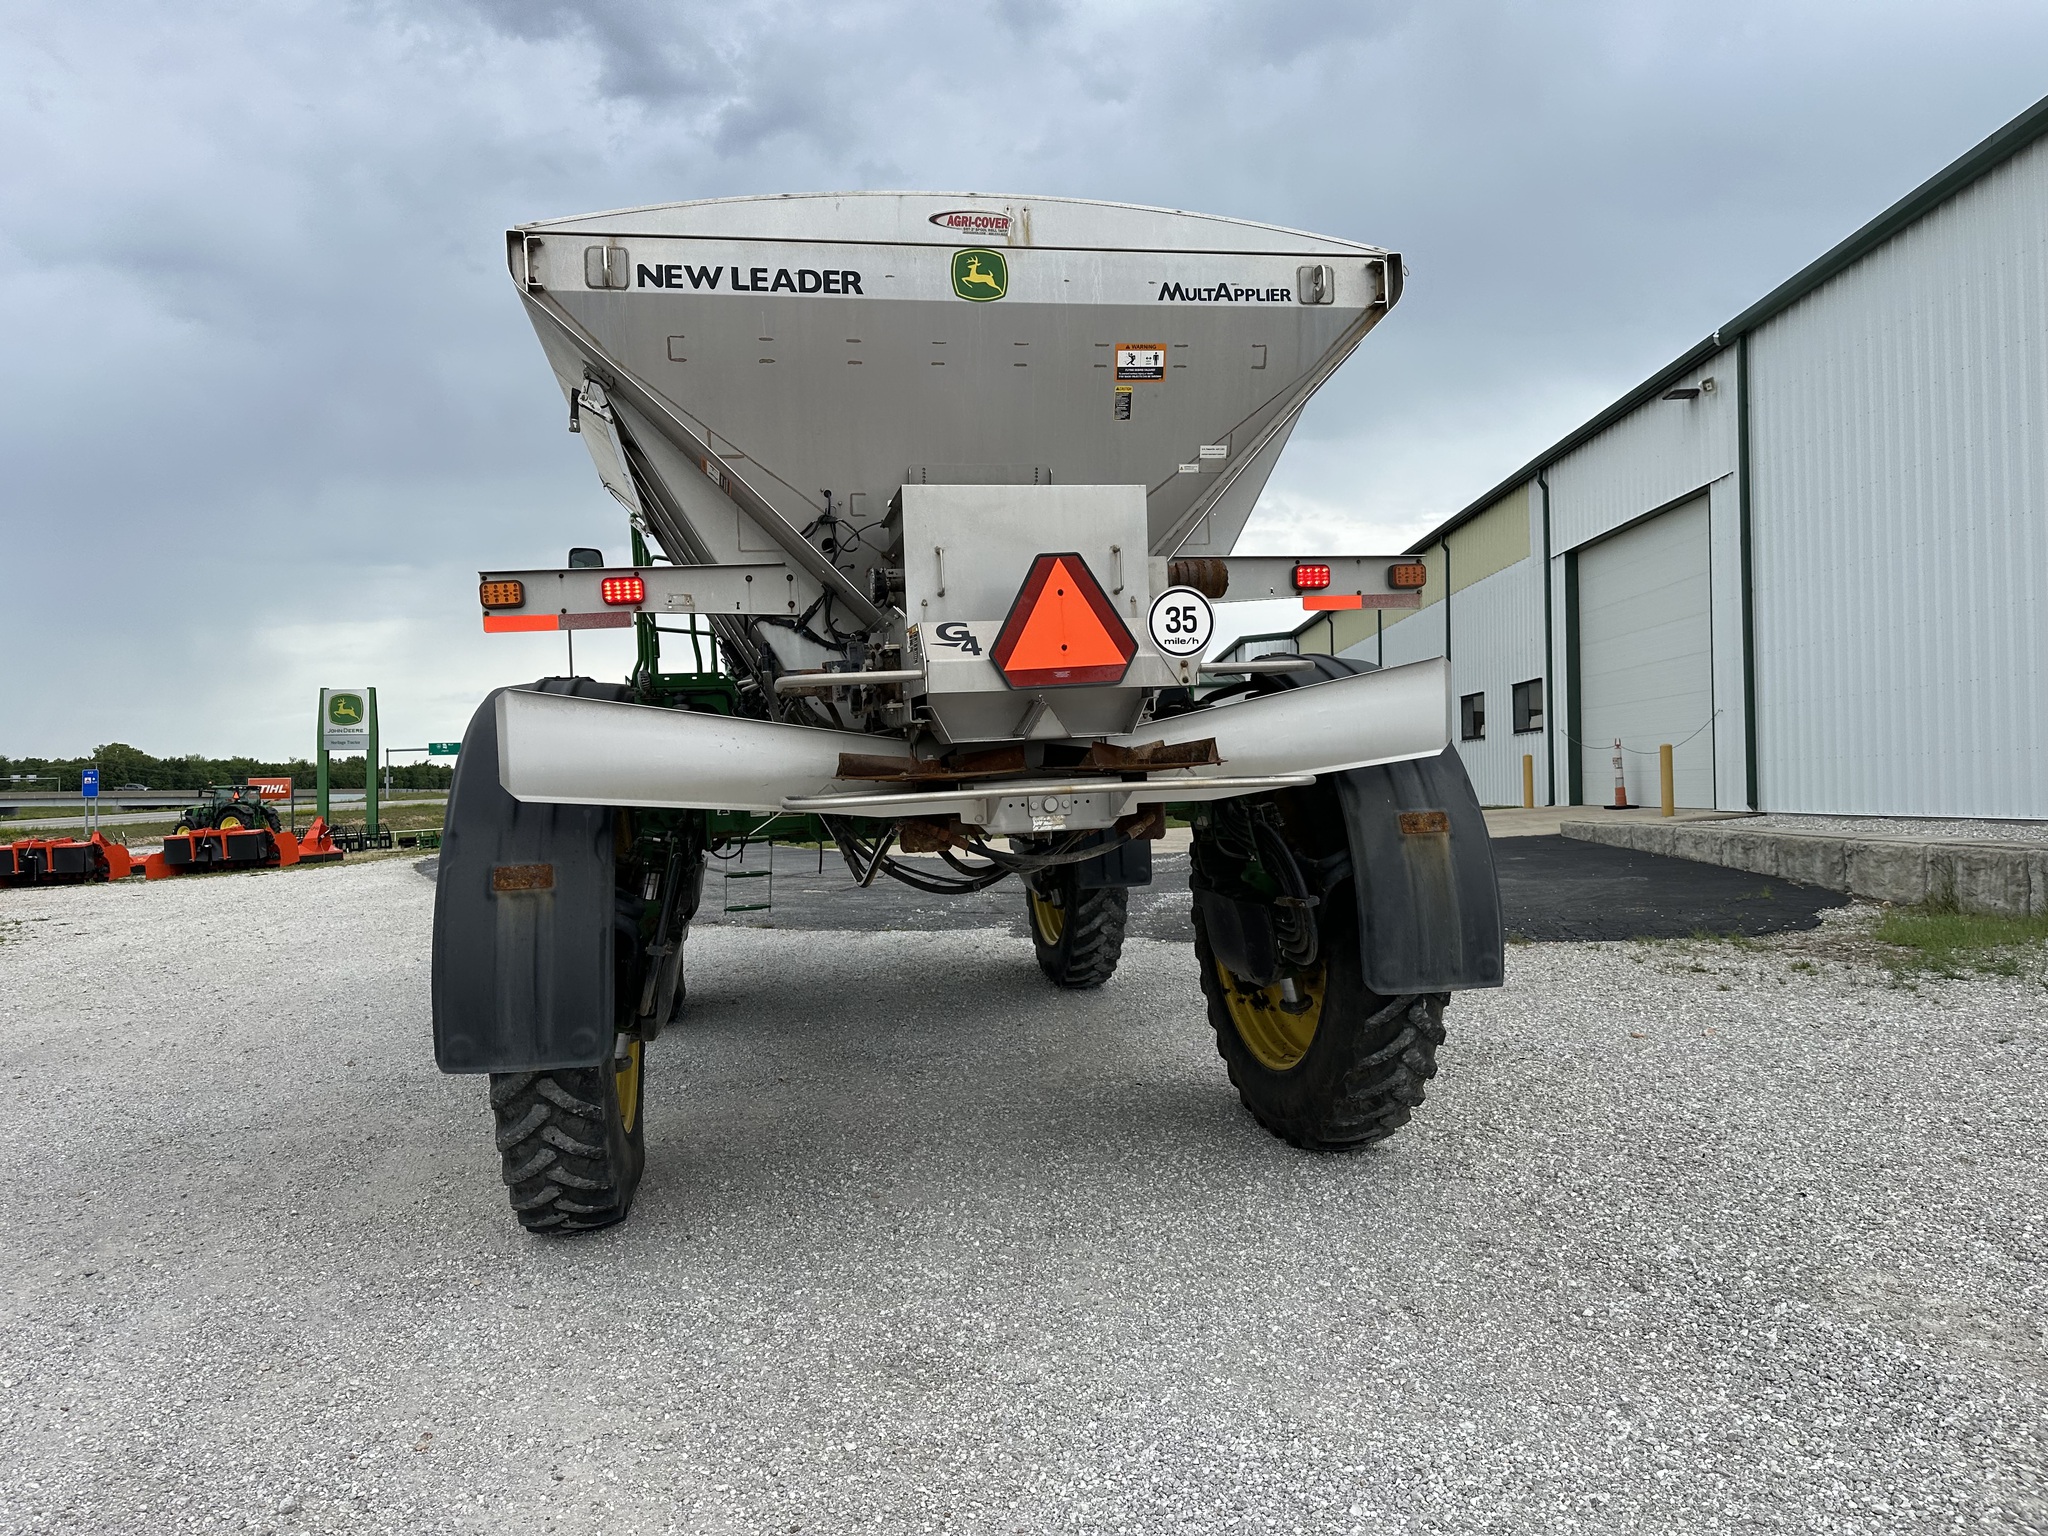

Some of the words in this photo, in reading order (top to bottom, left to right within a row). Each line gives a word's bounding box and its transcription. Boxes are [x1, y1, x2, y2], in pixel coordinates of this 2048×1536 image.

[947, 215, 1009, 229] AGRI-COVER
[637, 263, 724, 290] NEW
[731, 266, 864, 295] LEADER
[1165, 606, 1197, 634] 35
[936, 622, 983, 656] G4
[1164, 637, 1199, 645] mile/h
[258, 784, 287, 794] TIHL
